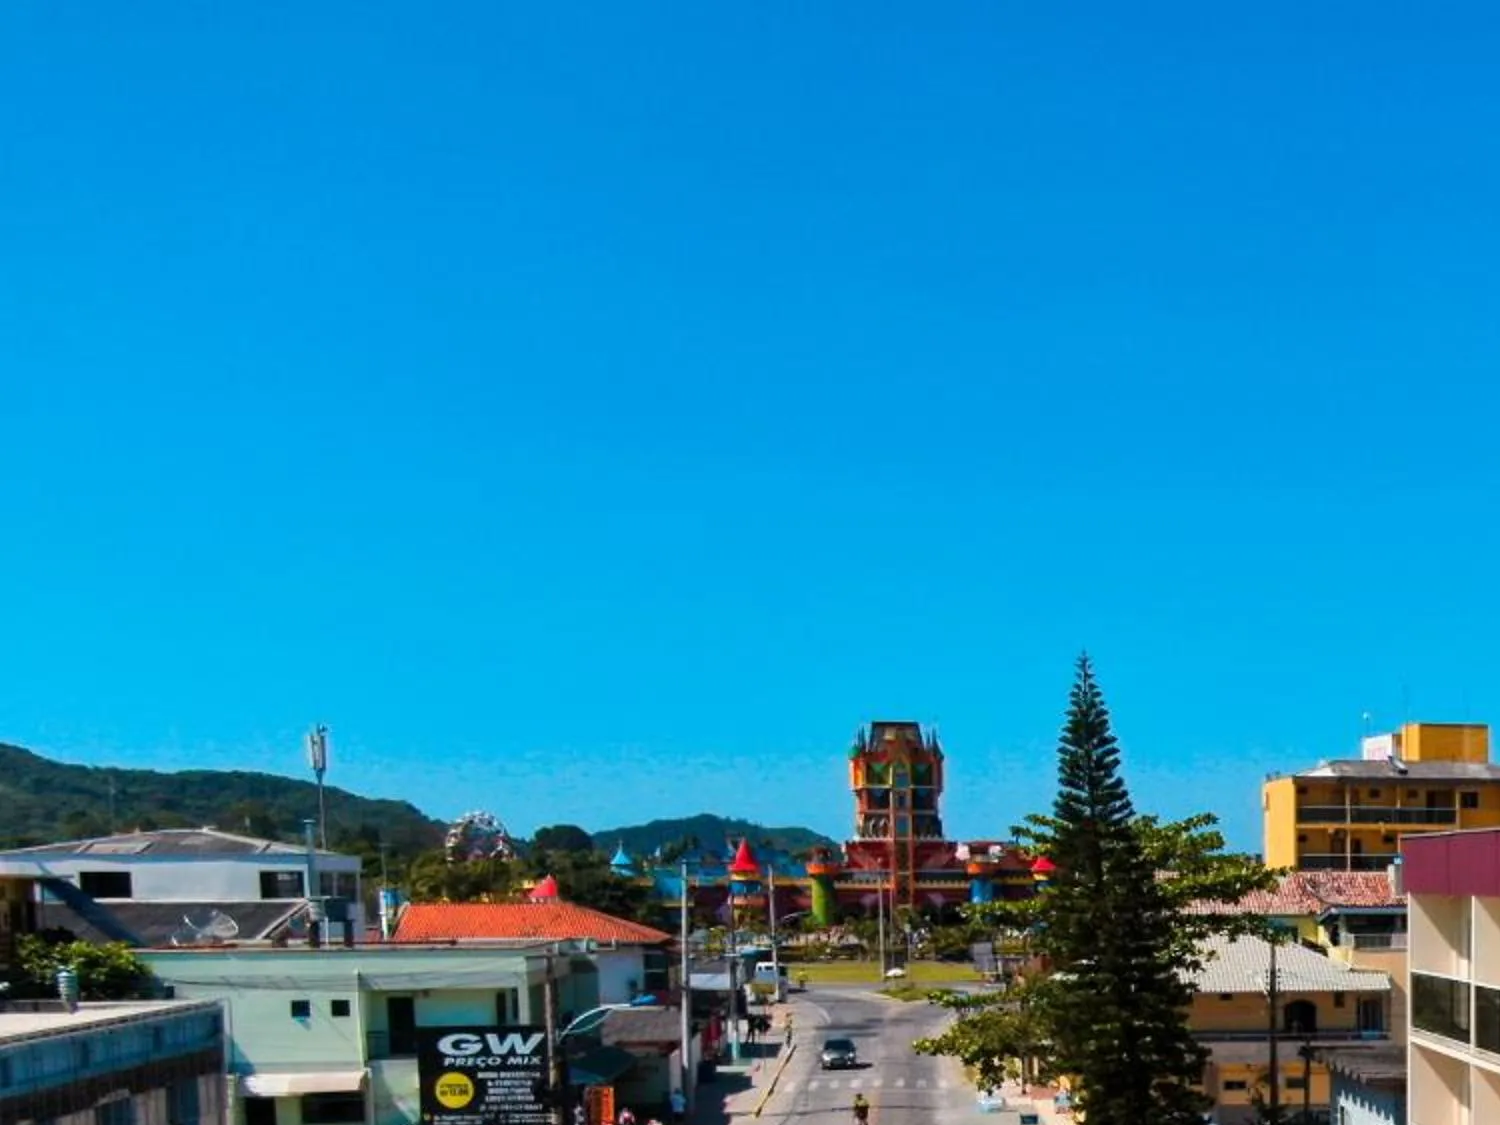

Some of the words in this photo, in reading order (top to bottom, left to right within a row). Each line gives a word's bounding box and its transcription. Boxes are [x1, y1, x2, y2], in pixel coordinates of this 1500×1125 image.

[436, 1032, 545, 1056] GW
[443, 1055, 501, 1068] PREÇO
[507, 1055, 542, 1066] MIX
